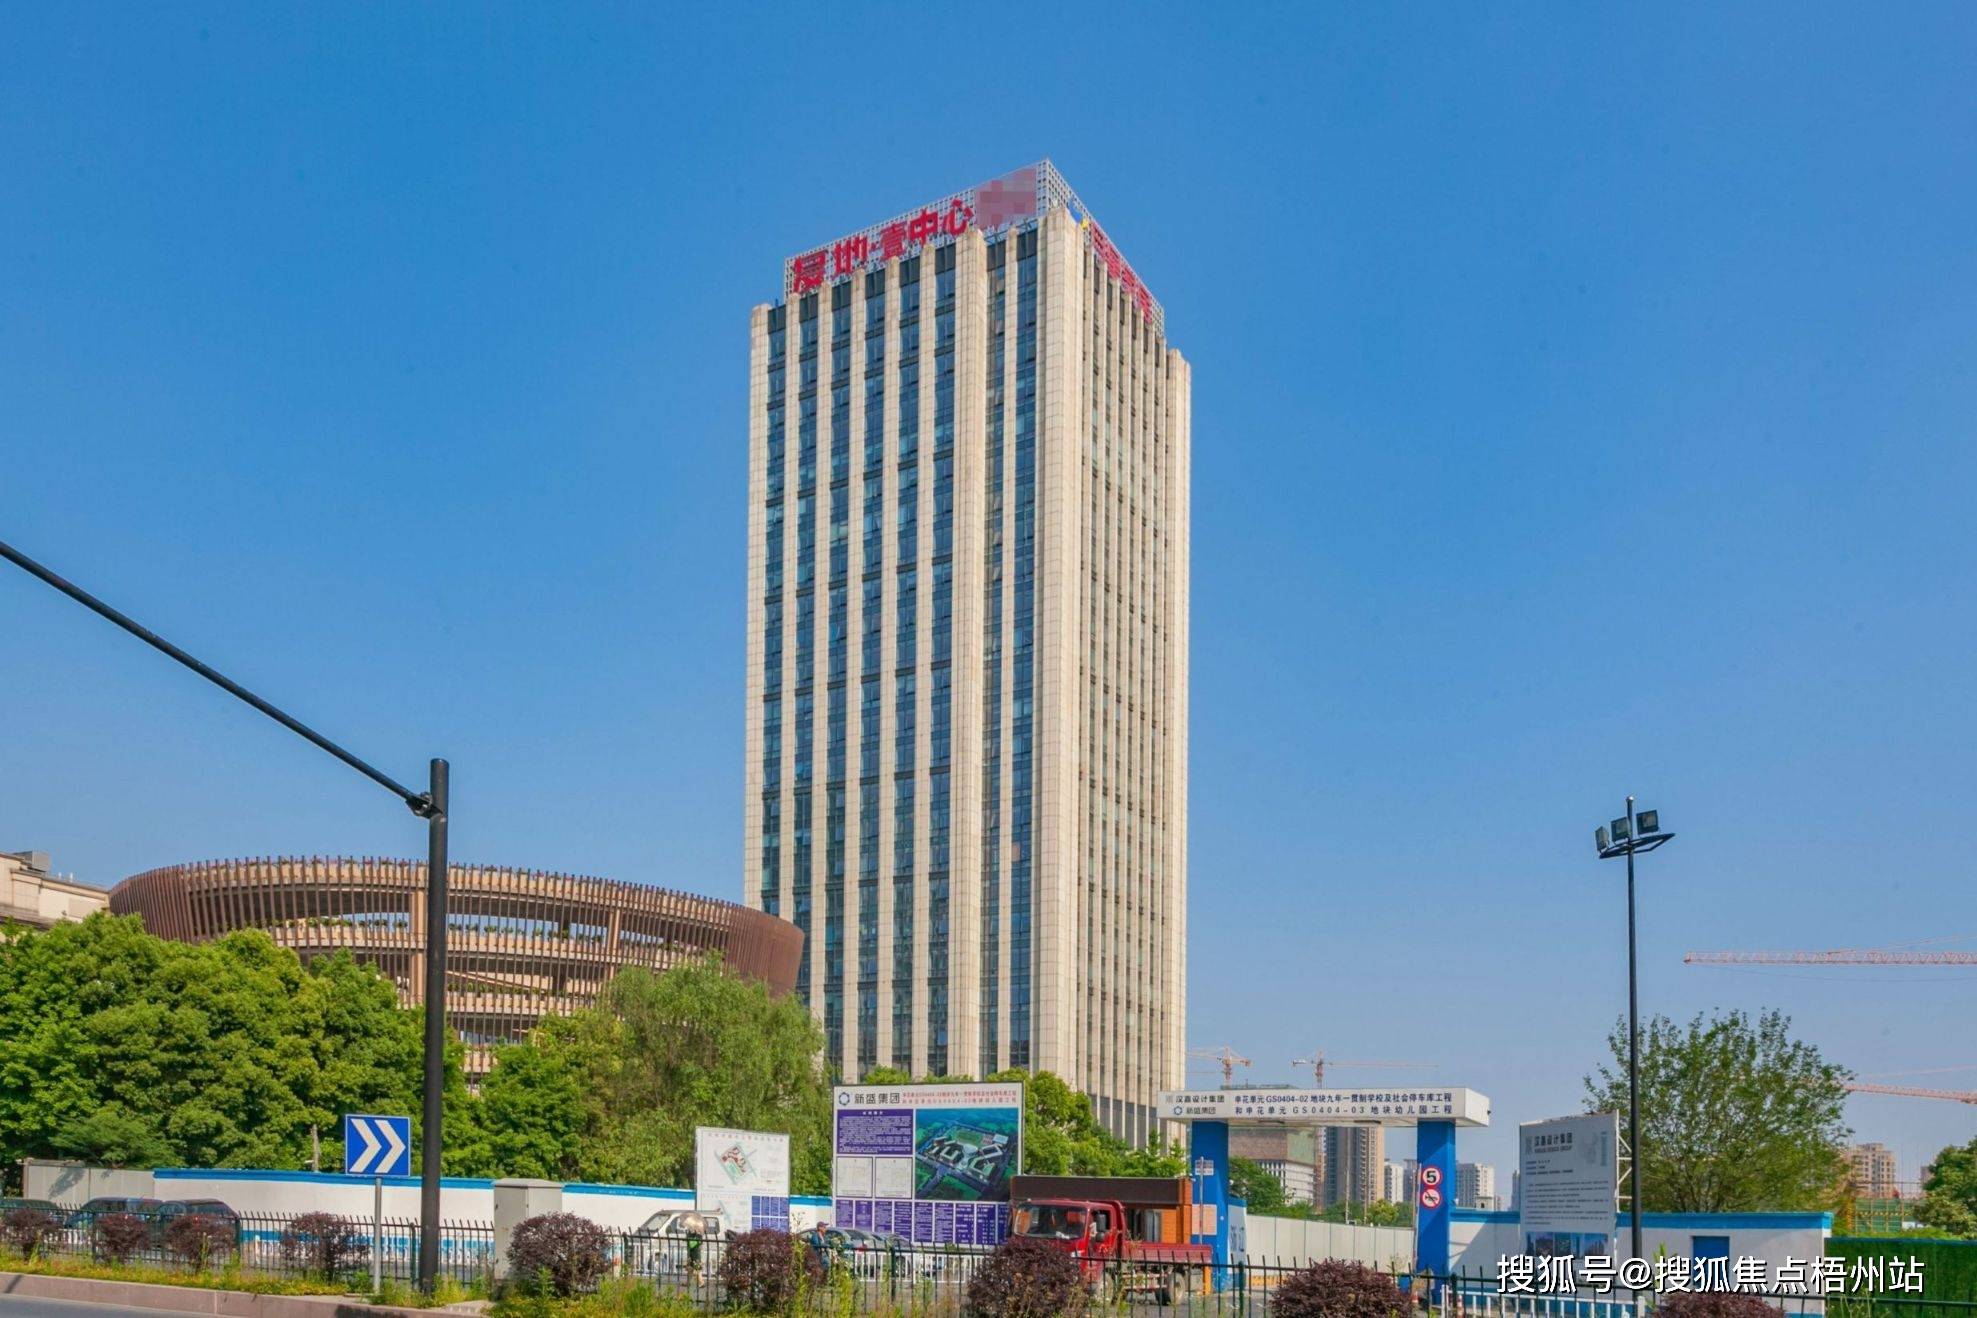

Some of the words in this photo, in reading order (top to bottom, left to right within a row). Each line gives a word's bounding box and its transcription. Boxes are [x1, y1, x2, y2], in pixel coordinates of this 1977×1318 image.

[854, 1092, 900, 1104] 新盛集团
[1426, 1170, 1437, 1184] 5
